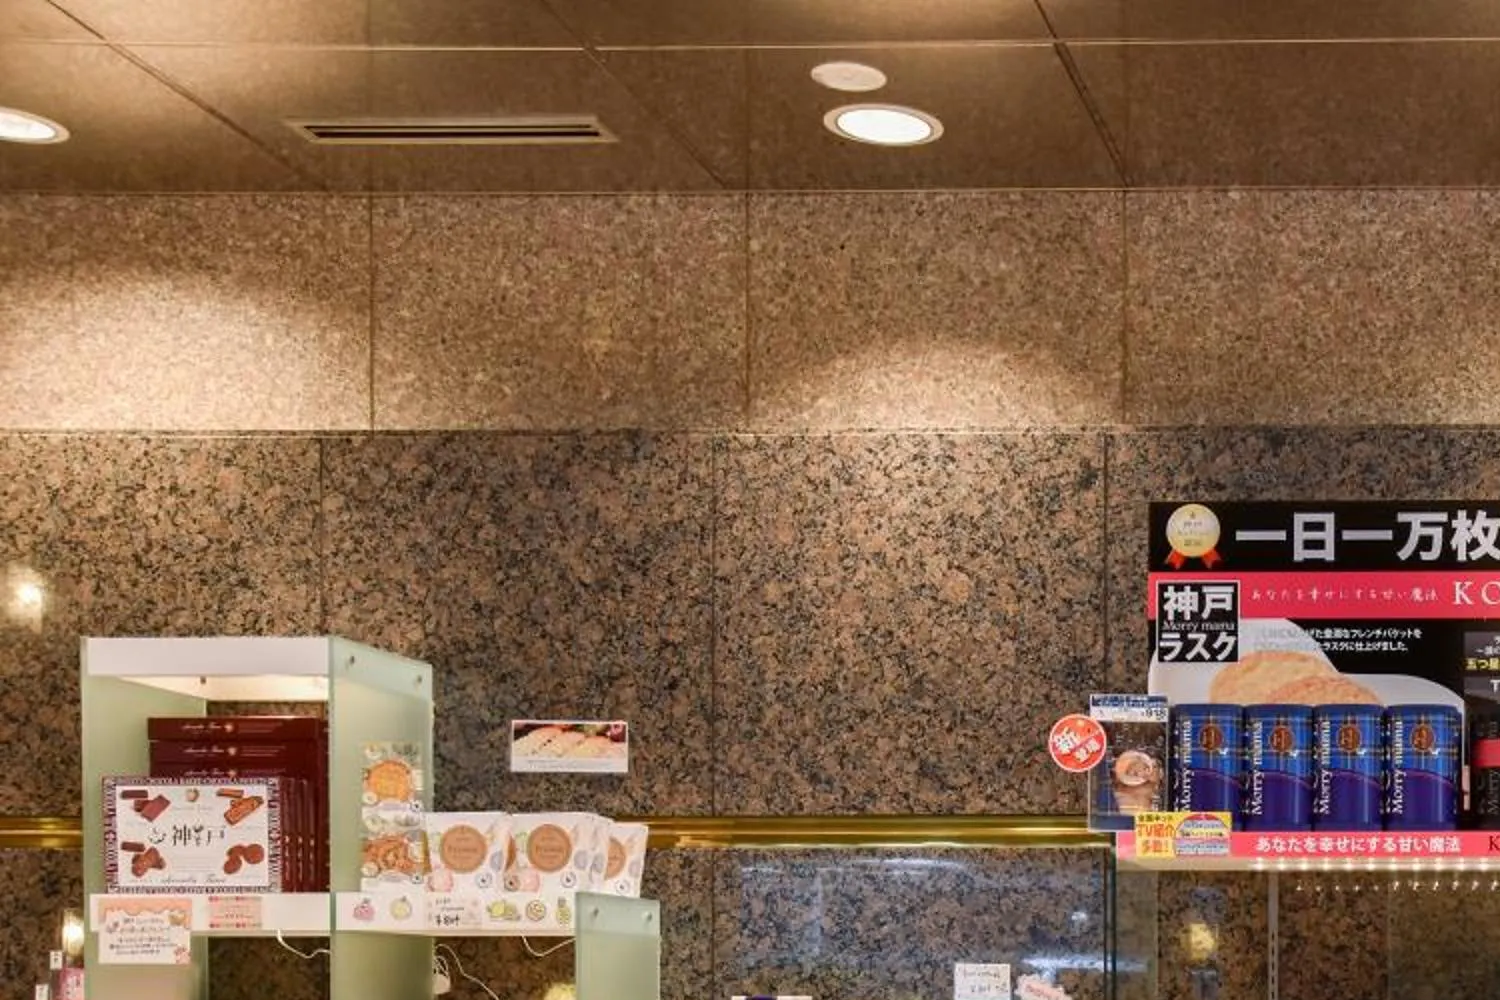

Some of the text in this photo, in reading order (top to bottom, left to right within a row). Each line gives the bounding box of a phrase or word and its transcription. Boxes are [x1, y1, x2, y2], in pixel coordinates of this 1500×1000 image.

[1162, 585, 1236, 621] 神戸
[1158, 632, 1238, 662] ラスク
[1256, 835, 1462, 854] あなたを幸せにする甘い魔法
